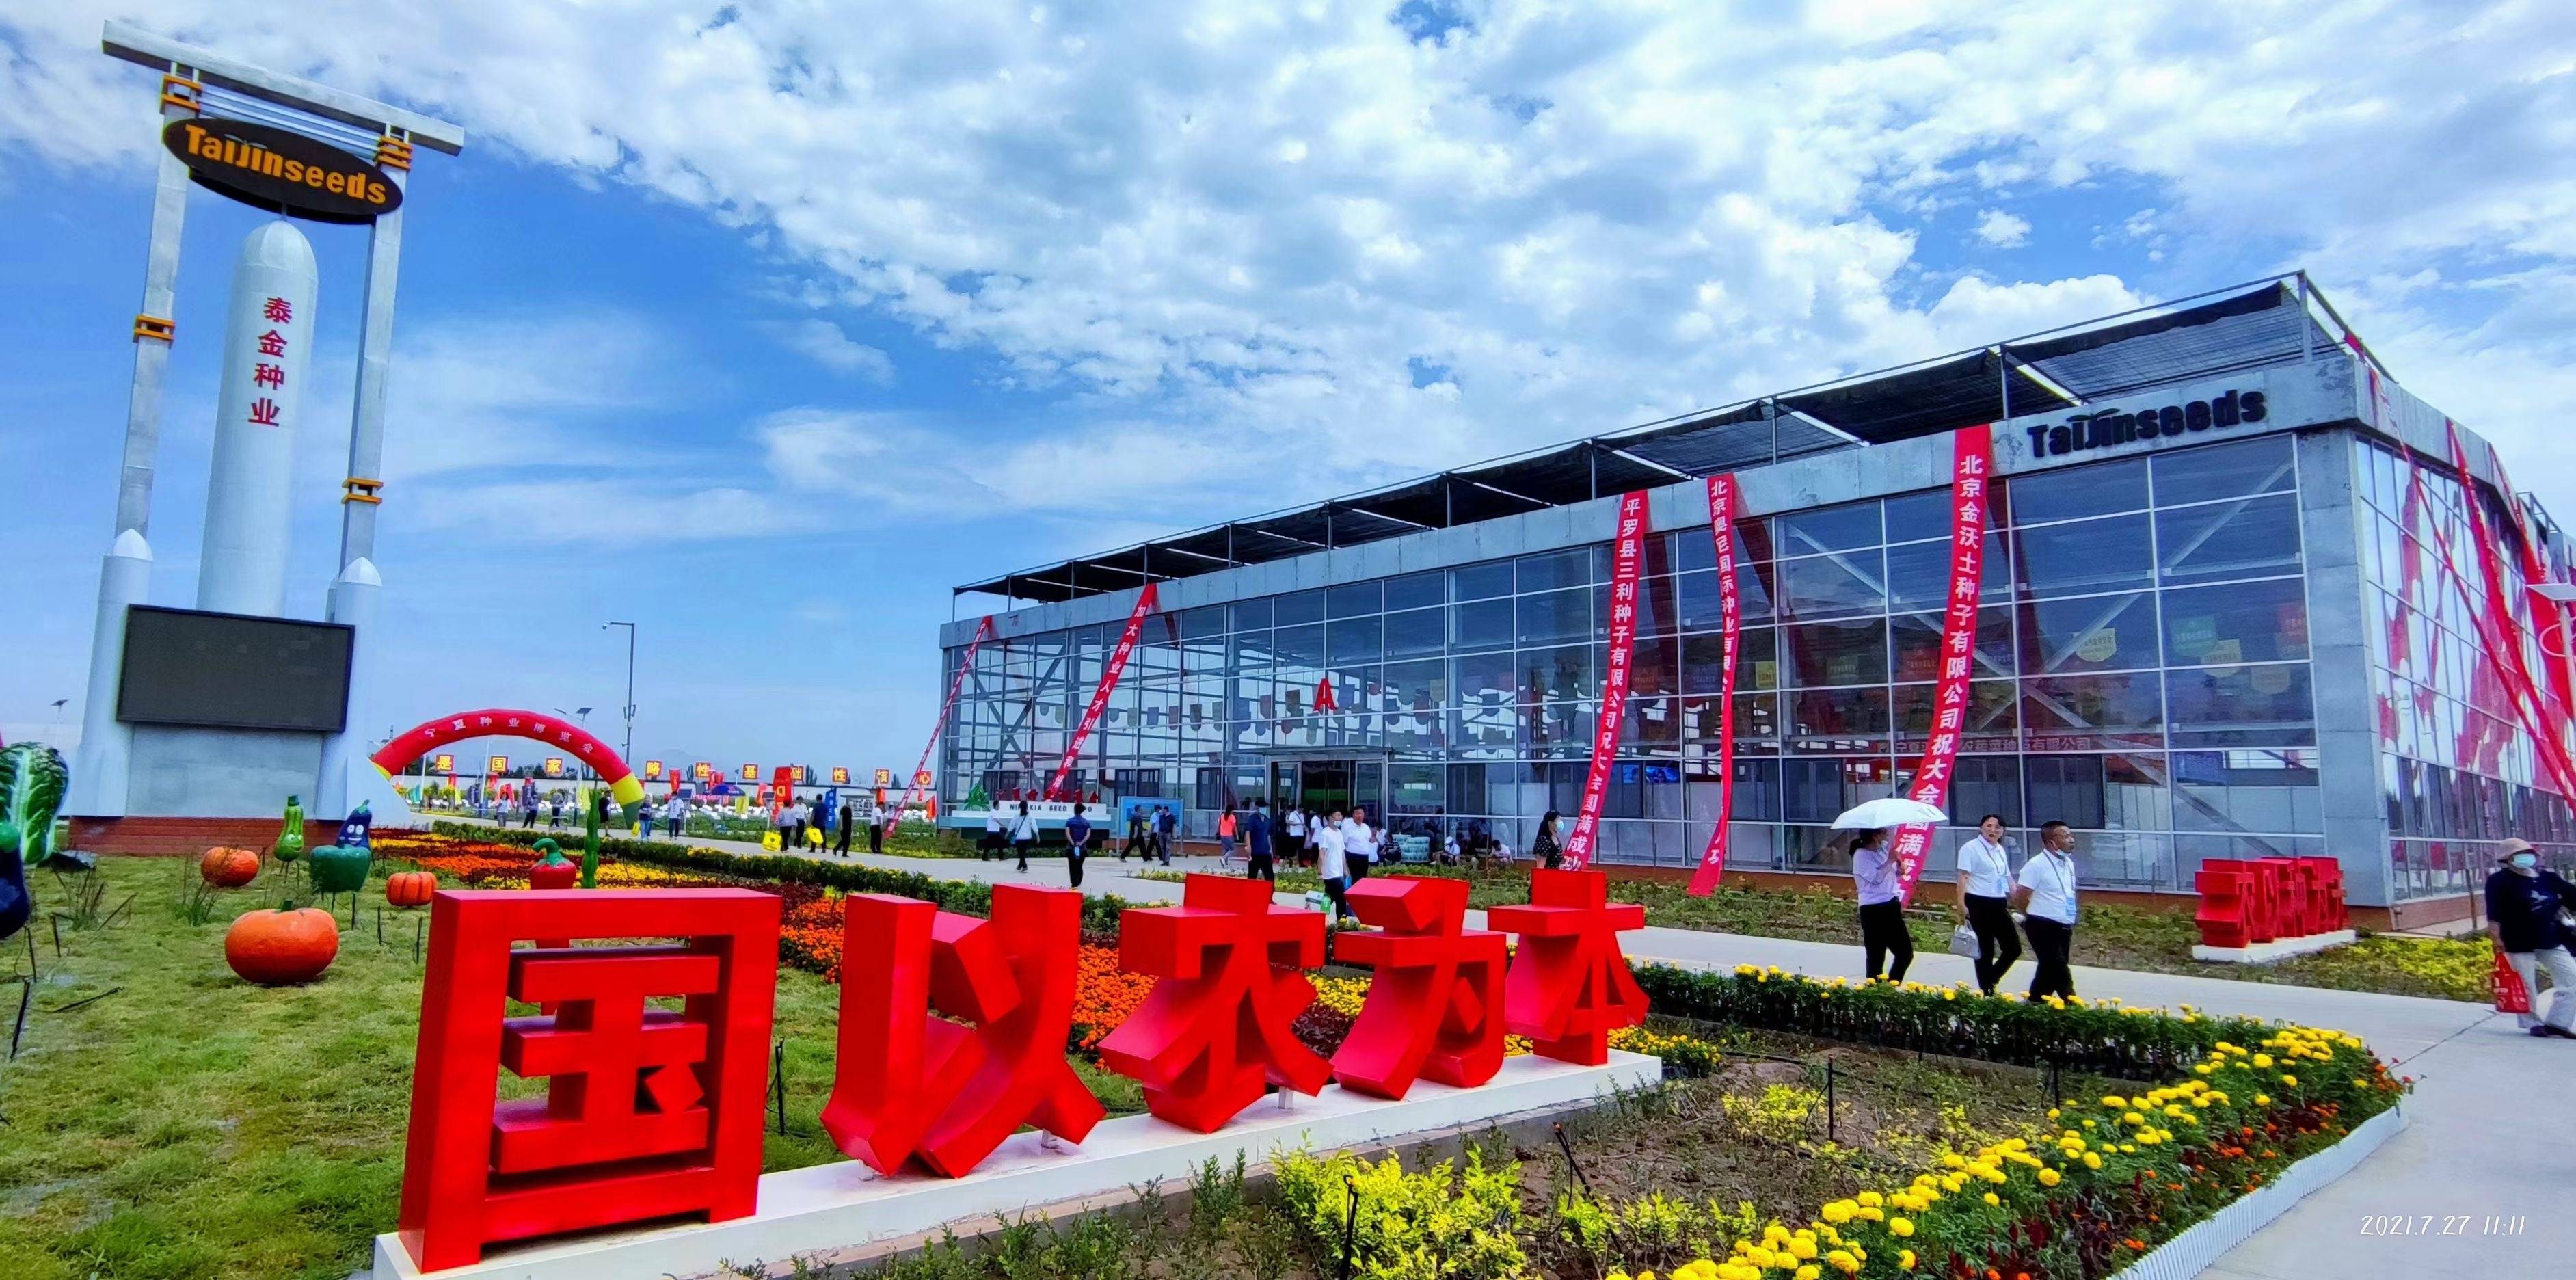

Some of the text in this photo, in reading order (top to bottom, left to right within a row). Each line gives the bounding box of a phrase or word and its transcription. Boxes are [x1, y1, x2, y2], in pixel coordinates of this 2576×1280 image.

[247, 297, 292, 426] 泰金种业
[424, 716, 594, 754] 宁夏种业博览会
[1313, 678, 1337, 712] A
[399, 868, 1650, 1272] 国以农为本
